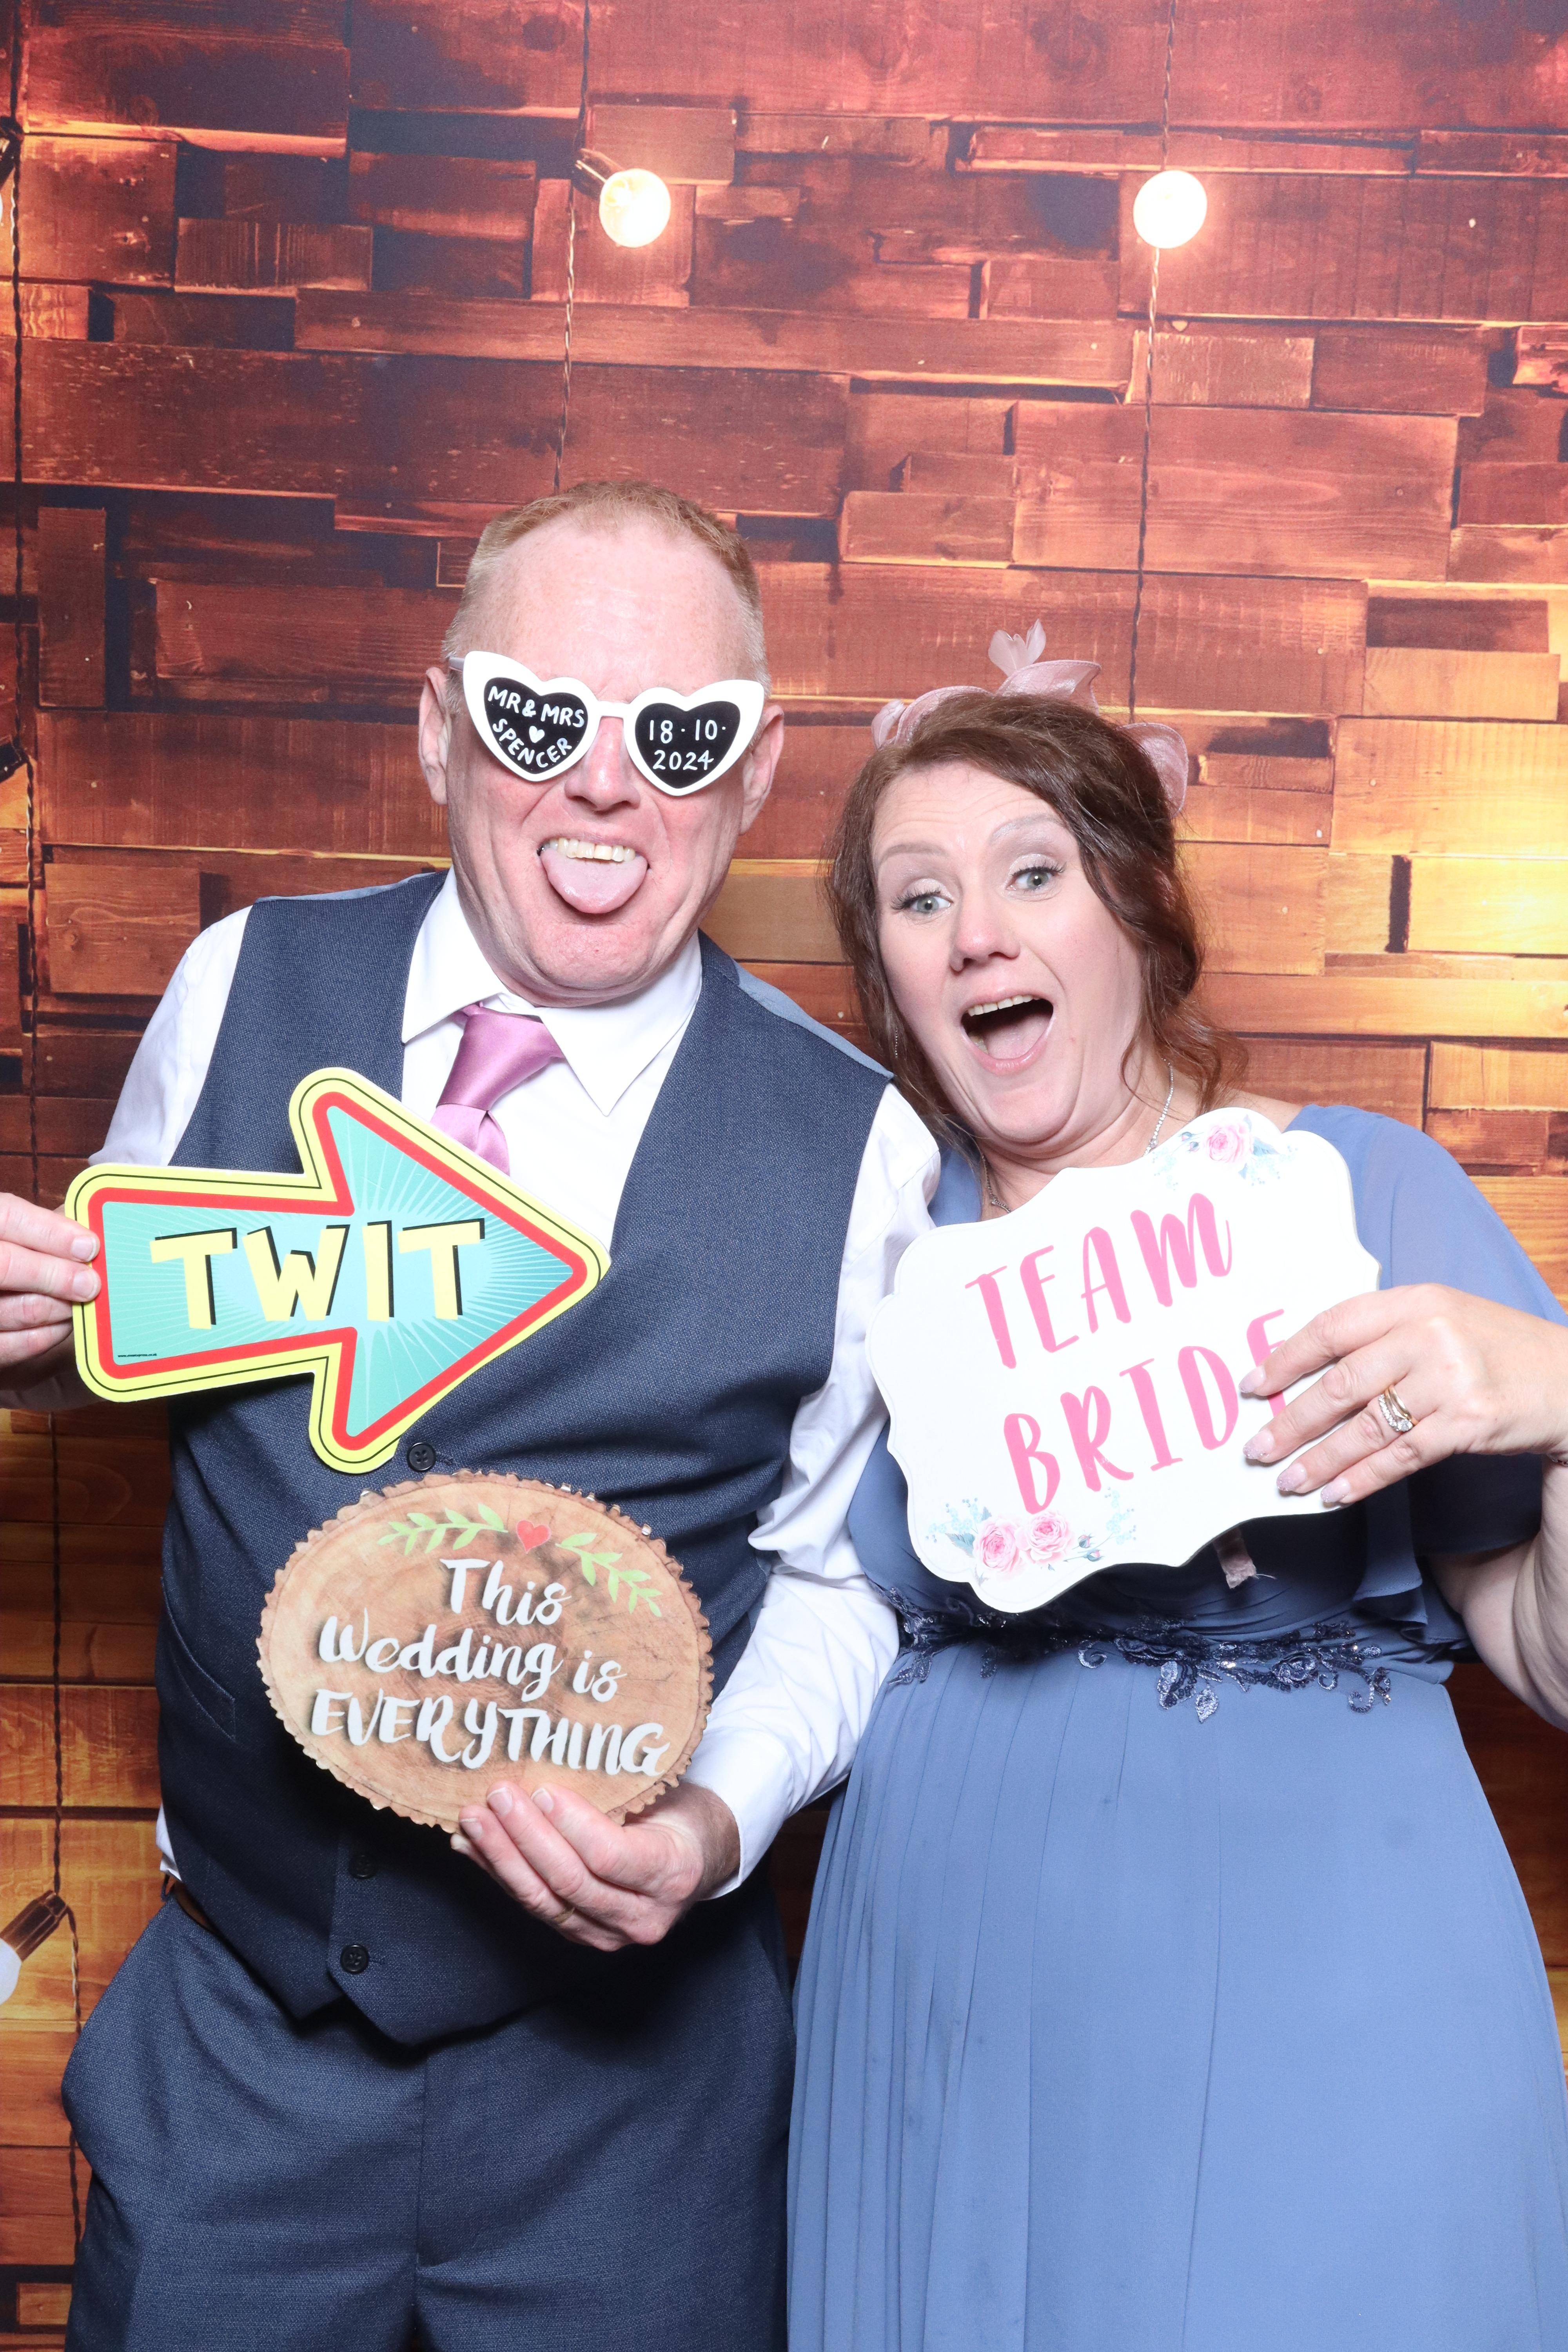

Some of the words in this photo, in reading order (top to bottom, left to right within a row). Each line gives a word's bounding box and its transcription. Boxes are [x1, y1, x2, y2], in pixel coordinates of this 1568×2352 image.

[492, 718, 572, 768] SPENCER
[540, 703, 585, 728] MRS
[652, 750, 714, 771] 2024
[150, 1218, 485, 1330] TWIT
[965, 1193, 1232, 1369] TEAM
[439, 1558, 572, 1626] This
[319, 1607, 564, 1702] Wedding
[572, 1650, 627, 1703] is
[311, 1687, 671, 1777] EVERYTHING
